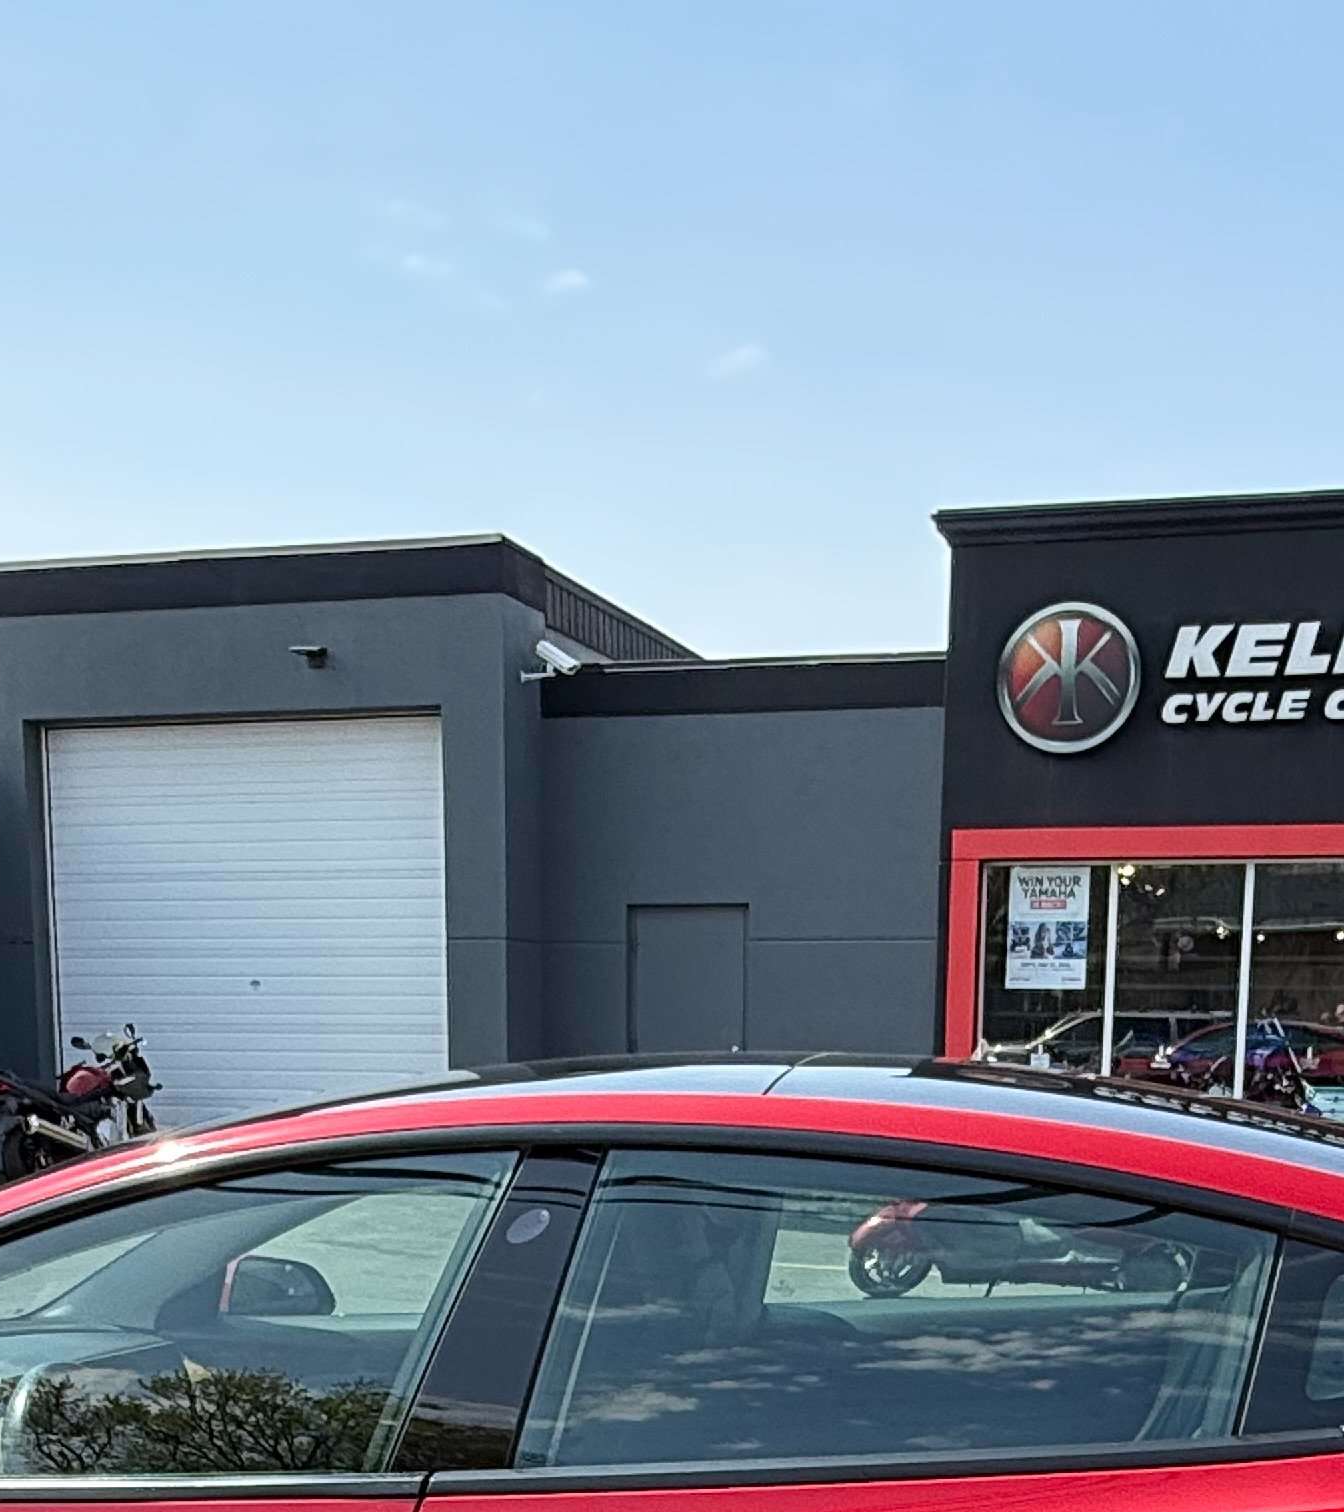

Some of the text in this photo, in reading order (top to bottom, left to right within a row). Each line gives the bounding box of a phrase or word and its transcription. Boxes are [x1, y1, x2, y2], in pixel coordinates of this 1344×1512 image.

[1161, 689, 1312, 724] CYCLE
[1017, 876, 1081, 887] WIN YOUR
[1022, 888, 1076, 899] YAMAHA
